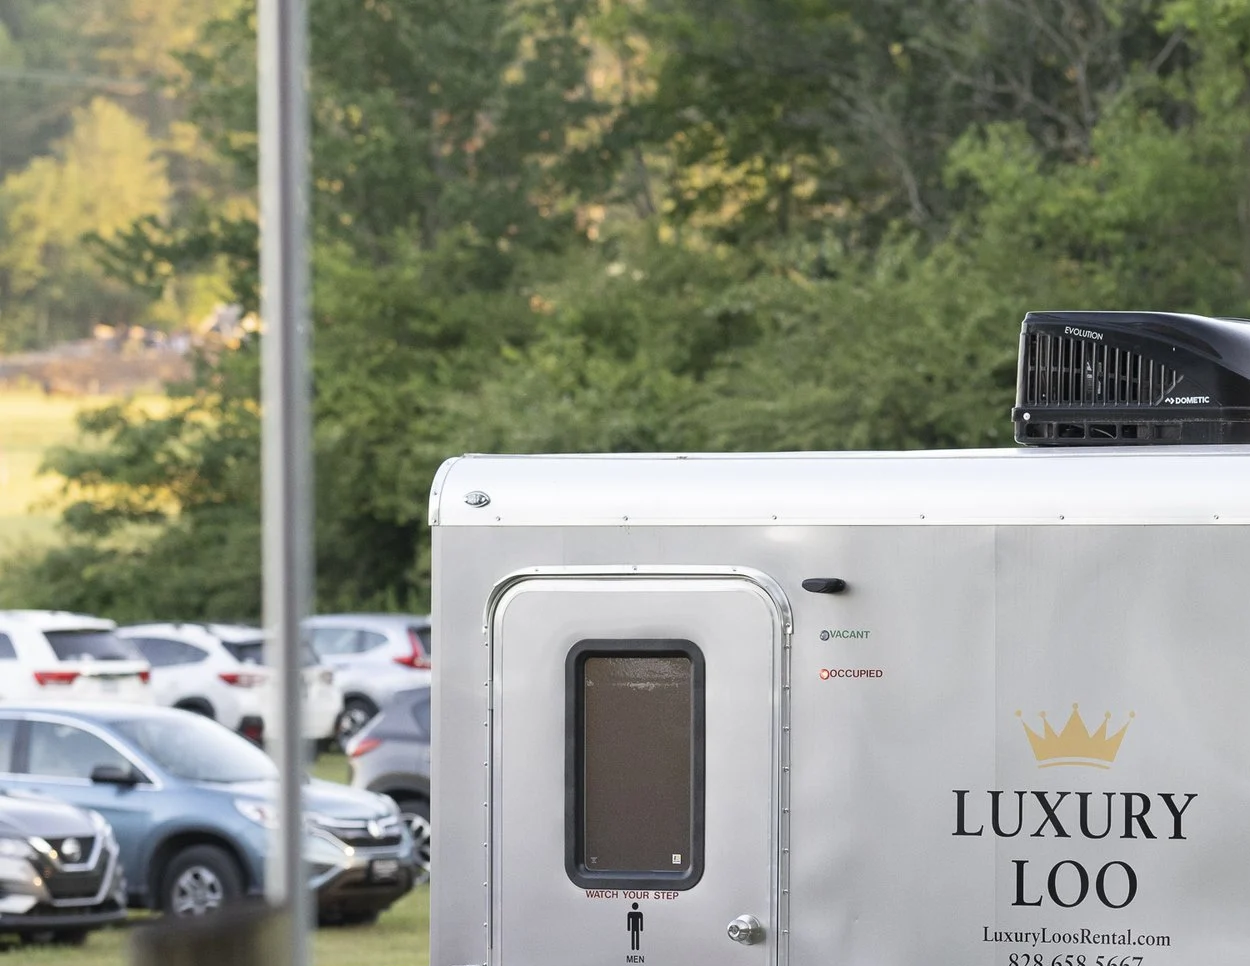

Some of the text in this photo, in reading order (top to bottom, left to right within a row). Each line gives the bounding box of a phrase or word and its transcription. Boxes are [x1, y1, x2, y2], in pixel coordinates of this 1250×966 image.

[1064, 326, 1104, 340] EVOLUTION
[1175, 396, 1210, 405] DOMETIC
[829, 630, 871, 639] VACANT
[829, 669, 883, 678] OCCUPIED
[952, 789, 1198, 840] LUXURY
[1011, 859, 1138, 909] LOO
[585, 890, 679, 900] WATCH YOUR STEP
[982, 926, 1171, 948] LuxuryLoosRental.com
[626, 955, 645, 964] MEN
